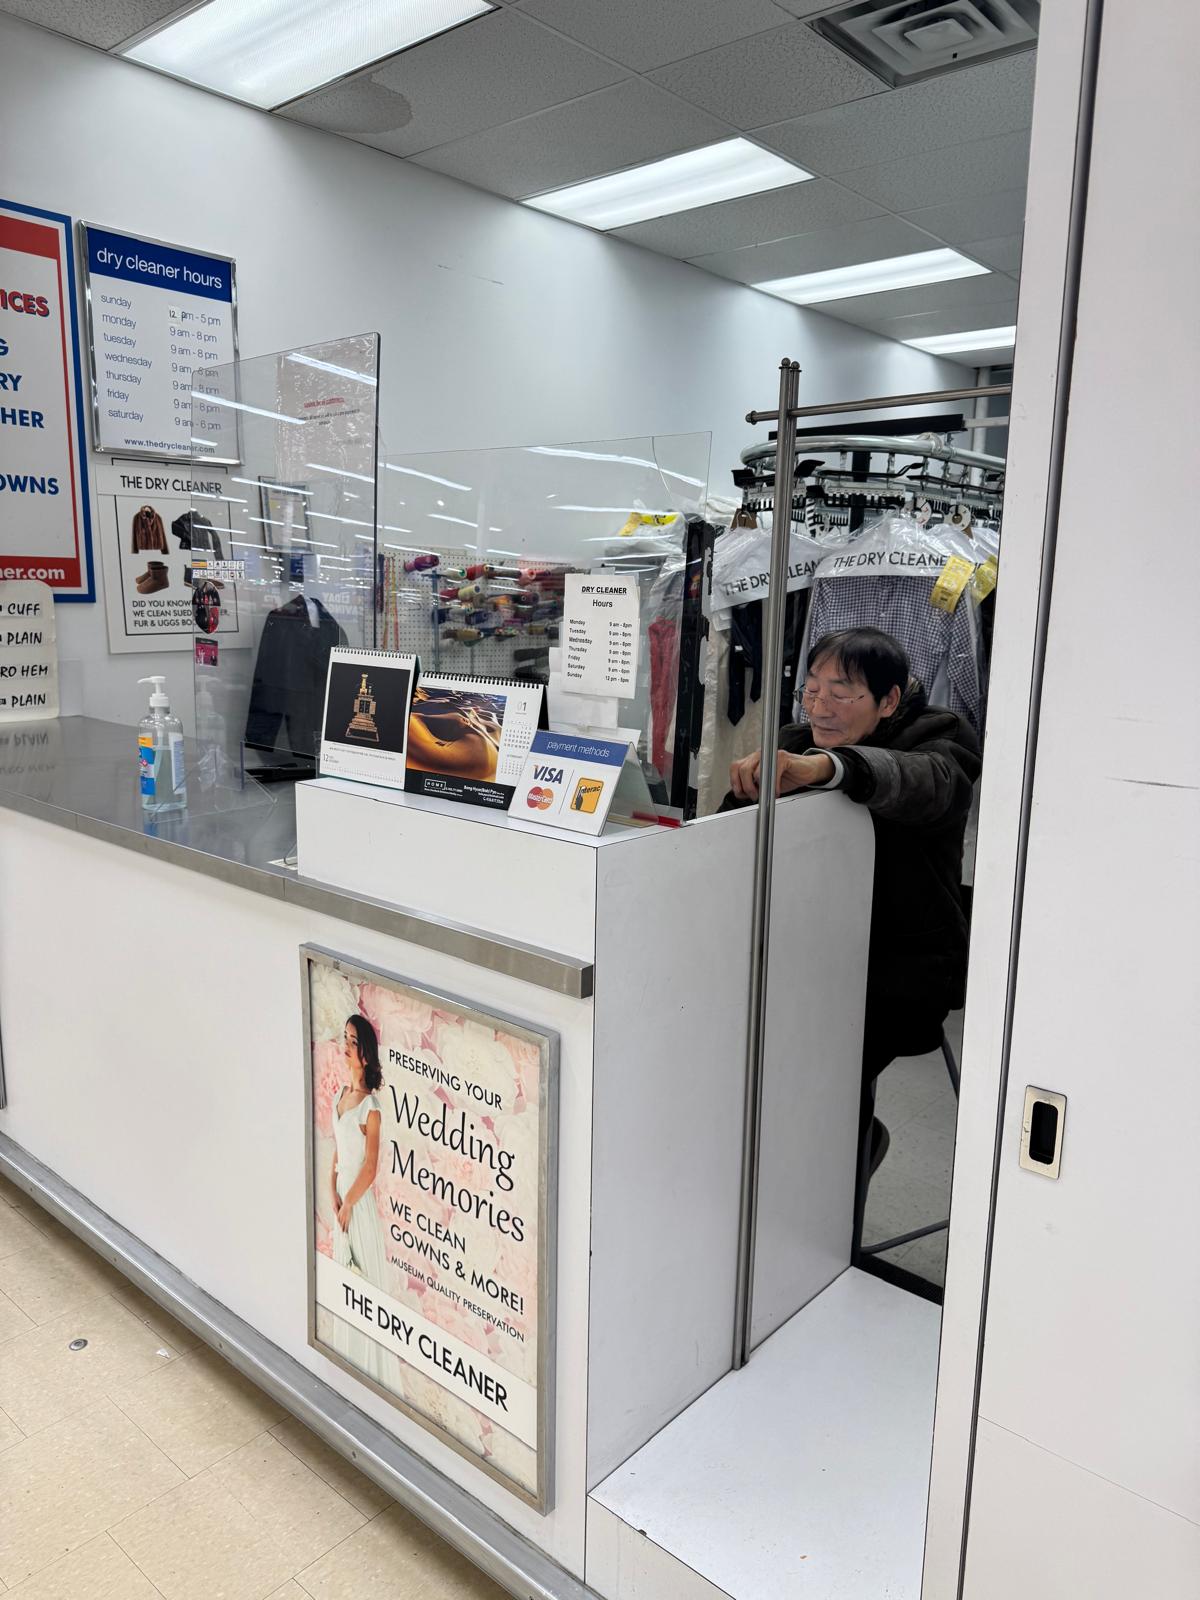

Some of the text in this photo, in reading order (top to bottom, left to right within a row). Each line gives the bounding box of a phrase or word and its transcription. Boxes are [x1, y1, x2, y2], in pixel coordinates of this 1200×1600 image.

[97, 248, 222, 289] dry cleaner hours
[101, 294, 131, 309] sunday
[169, 310, 177, 318] 12
[201, 314, 206, 323] 5
[208, 317, 221, 326] pm
[102, 314, 136, 329] monday
[170, 326, 176, 336] 9
[177, 330, 190, 338] am
[197, 331, 202, 340] 8
[204, 334, 217, 343] pm
[103, 332, 136, 348] tuesday
[171, 344, 177, 354] 9
[178, 347, 191, 355] am
[198, 349, 203, 358] 8
[205, 352, 218, 360] pm
[105, 353, 152, 368] wednesday
[172, 362, 177, 372] 9
[179, 366, 191, 374] am
[106, 370, 142, 385] thursday
[173, 381, 178, 390] 9
[107, 388, 129, 402] friday
[174, 399, 179, 408] 9
[206, 405, 220, 413] pm
[0, 407, 44, 428] HER
[108, 409, 144, 422] saturday
[175, 417, 180, 426] 9
[208, 422, 221, 430] pm
[124, 439, 215, 453] www.thedrycleaner.com
[120, 475, 223, 494] THE DRY CLEANER
[833, 555, 857, 568] THE
[857, 552, 886, 566] DRY
[0, 567, 65, 580] er.com
[750, 572, 769, 588] DR
[7, 603, 40, 615] CUFF
[592, 599, 613, 607] Hours
[157, 619, 180, 627] UGGS
[570, 619, 585, 627] Monday
[7, 631, 42, 645] PLAIN
[568, 637, 592, 645] Wednesday
[21, 665, 48, 677] HEM
[11, 693, 46, 708] PLAIN
[546, 741, 610, 757] payment methods
[533, 764, 564, 784] VISA
[389, 1049, 503, 1110] PRESERVING YOUR
[389, 1084, 515, 1191] Wedding
[390, 1140, 524, 1242] Memories
[390, 1196, 466, 1254] WE CLEAN
[390, 1224, 524, 1315] GOWNS & MORE!
[391, 1256, 525, 1342] MUSEUM QUALITY PRESERVATION
[342, 1283, 508, 1412] THE DRY CLEANER
